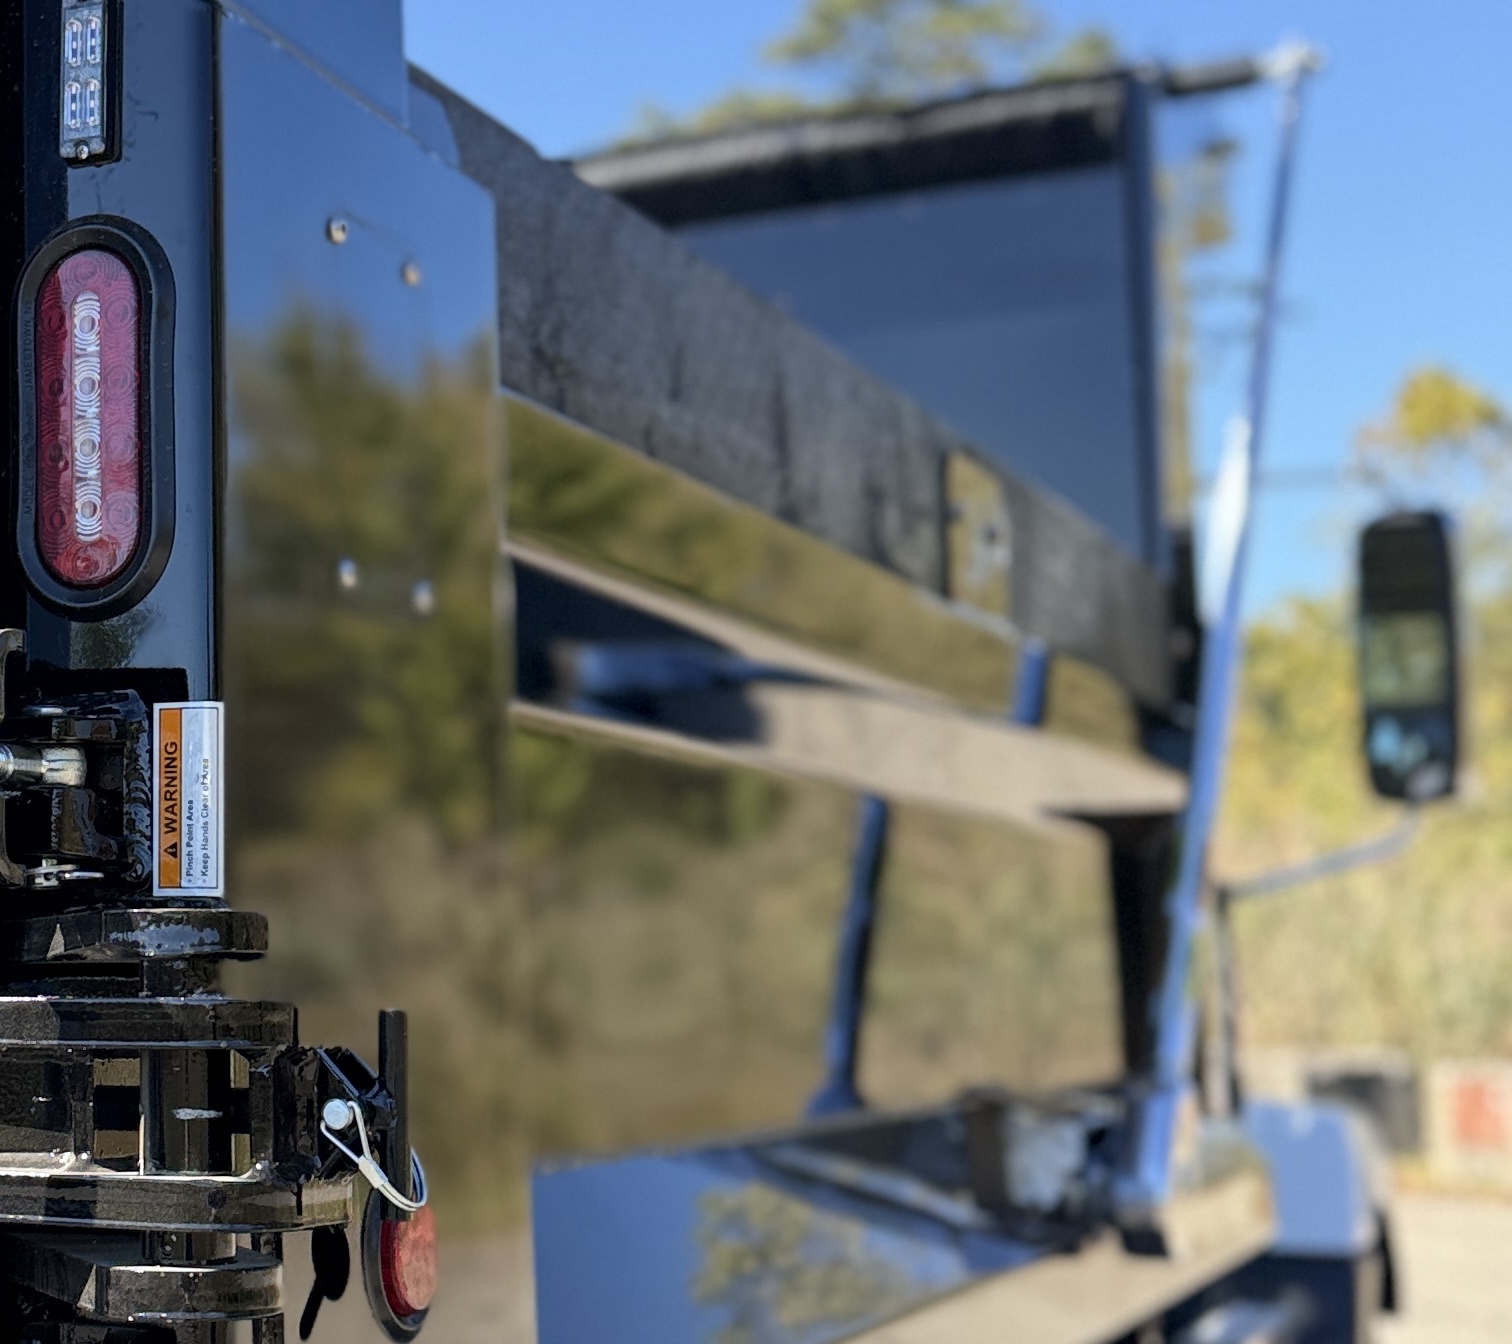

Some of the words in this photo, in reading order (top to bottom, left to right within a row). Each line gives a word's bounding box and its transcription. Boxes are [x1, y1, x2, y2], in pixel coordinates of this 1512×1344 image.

[201, 758, 209, 780] Area
[164, 741, 178, 835] WARNING
[186, 799, 194, 822] Area
[201, 794, 209, 819] Clear
[186, 823, 194, 848] Point
[201, 821, 209, 851] Hands
[186, 850, 194, 877] Pinch
[201, 853, 210, 877] Keep
